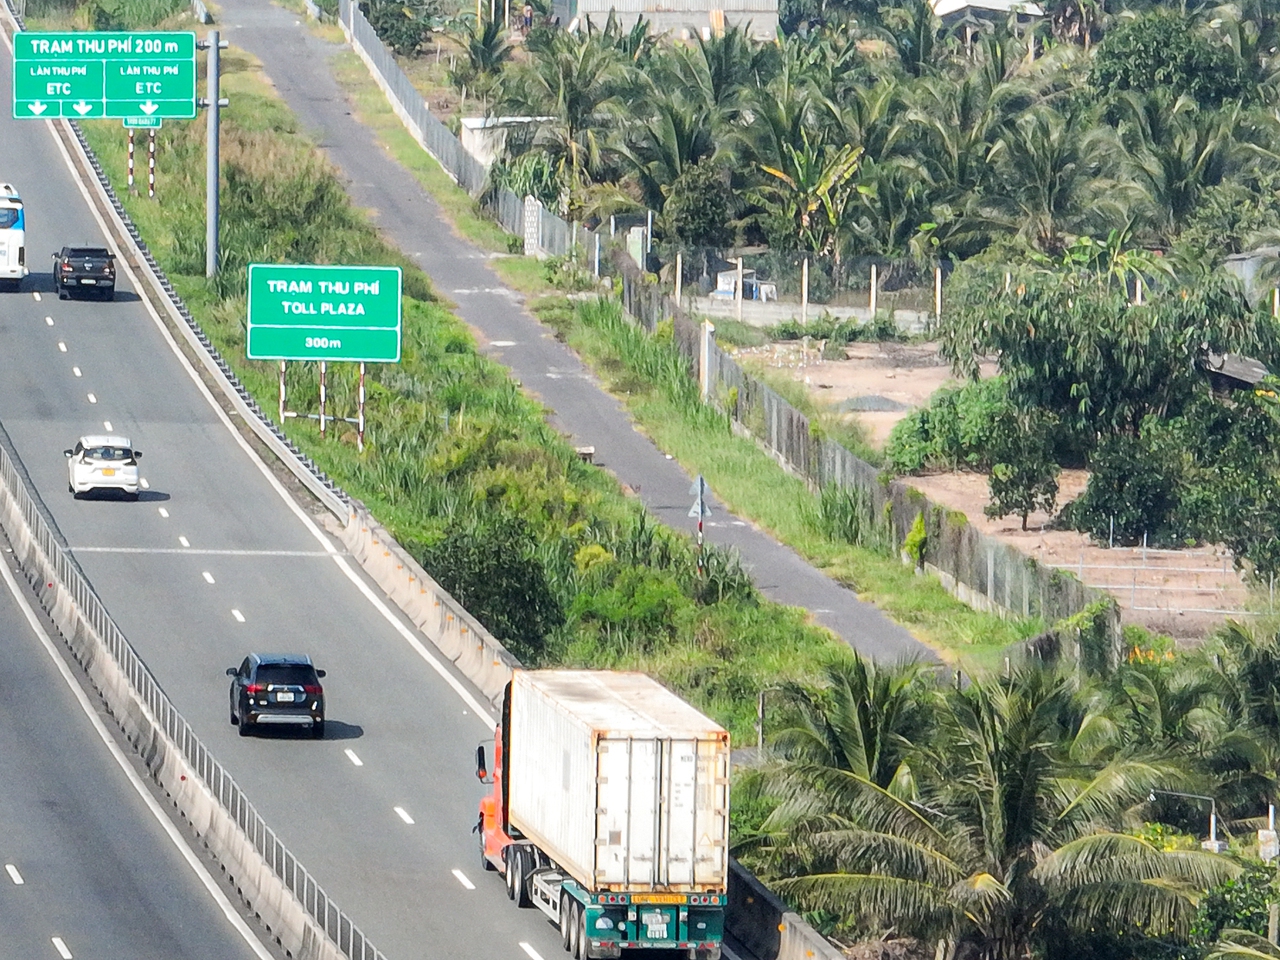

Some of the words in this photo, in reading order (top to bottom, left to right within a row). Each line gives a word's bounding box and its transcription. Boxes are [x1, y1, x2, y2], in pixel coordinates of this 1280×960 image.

[31, 39, 72, 57] TRẠM
[76, 39, 105, 53] THU
[108, 36, 132, 53] PHÍ
[135, 39, 162, 53] 200
[165, 42, 178, 53] m
[30, 65, 52, 76] LÀN
[52, 66, 70, 76] THU
[71, 65, 87, 76] PHÍ
[120, 65, 140, 76] LÀN
[143, 66, 161, 75] THU
[163, 64, 179, 75] PHÍ
[46, 82, 71, 95] ETC
[135, 82, 162, 94] ETC
[267, 280, 312, 296] TRẠM
[318, 281, 350, 295] THU
[354, 280, 380, 295] PHÍ
[282, 301, 317, 314] TOLL
[320, 302, 366, 316] PLAZA
